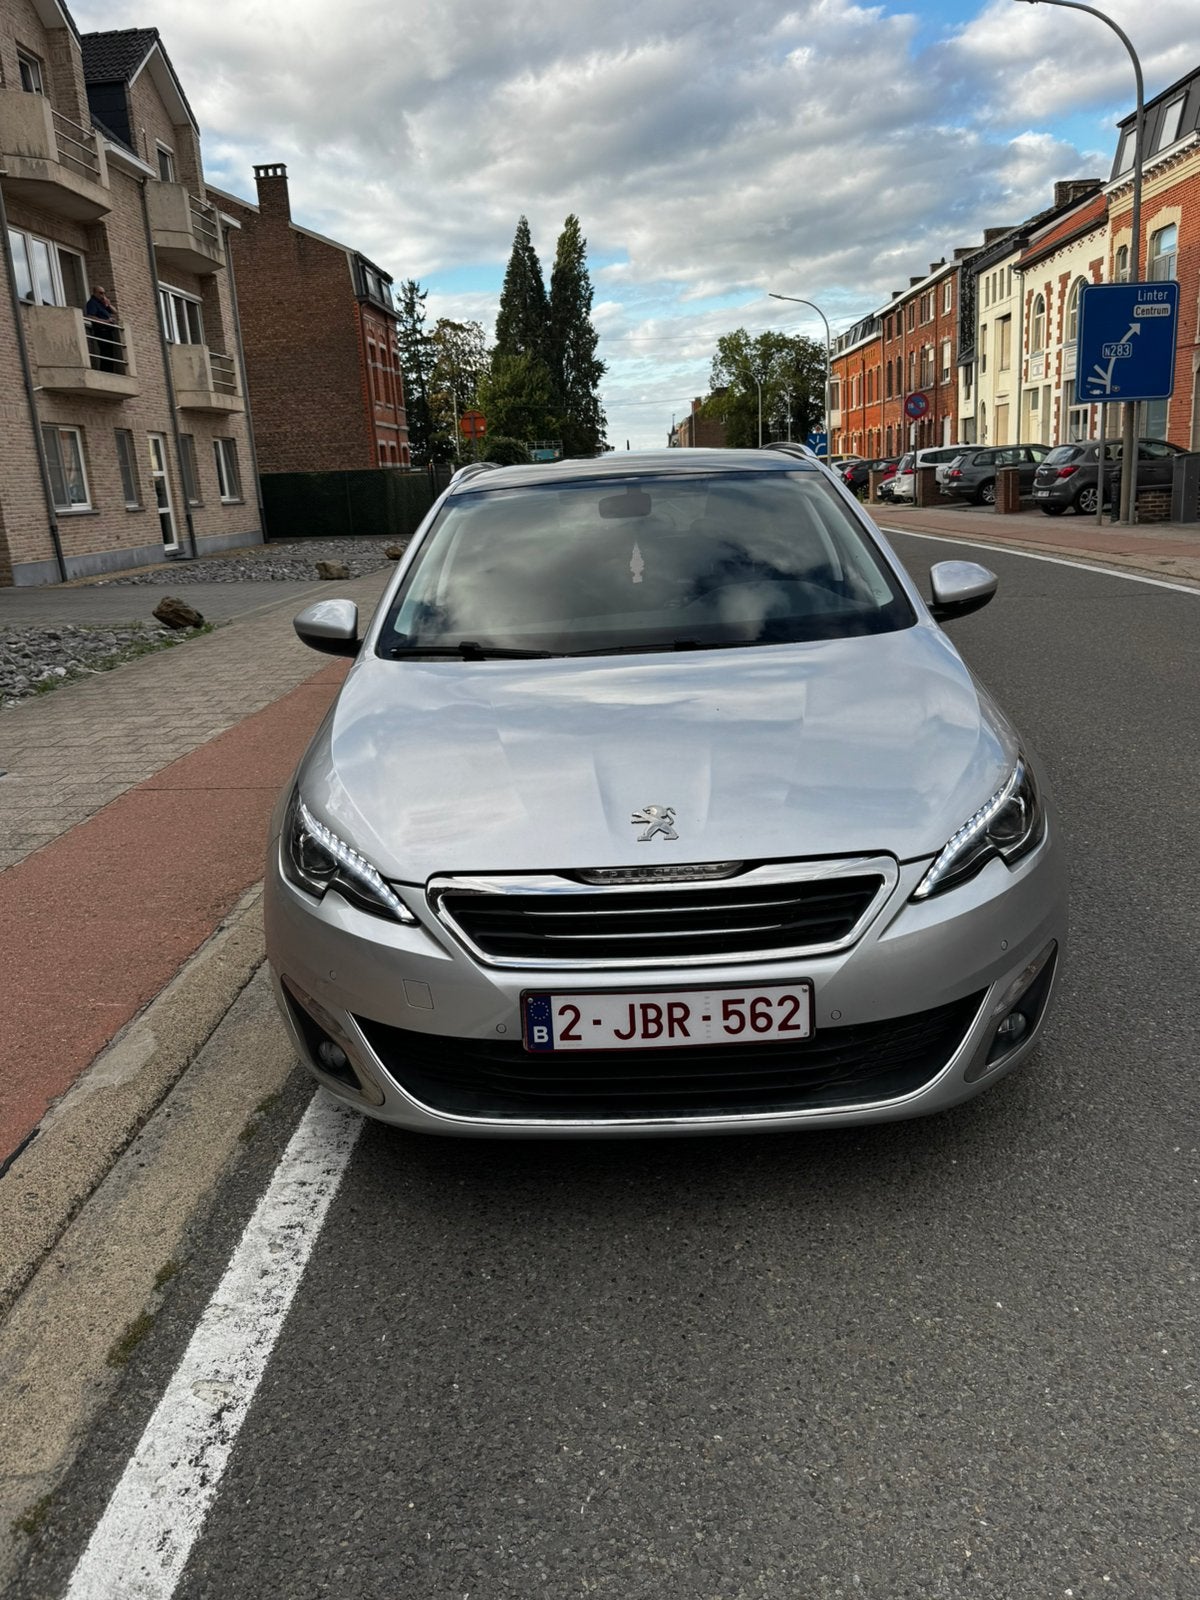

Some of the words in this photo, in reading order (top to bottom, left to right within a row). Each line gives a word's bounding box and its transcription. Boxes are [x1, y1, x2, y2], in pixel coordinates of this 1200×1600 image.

[1137, 290, 1168, 301] Linter
[1135, 306, 1169, 316] Centrum
[1104, 345, 1130, 356] N283
[533, 1026, 549, 1043] B
